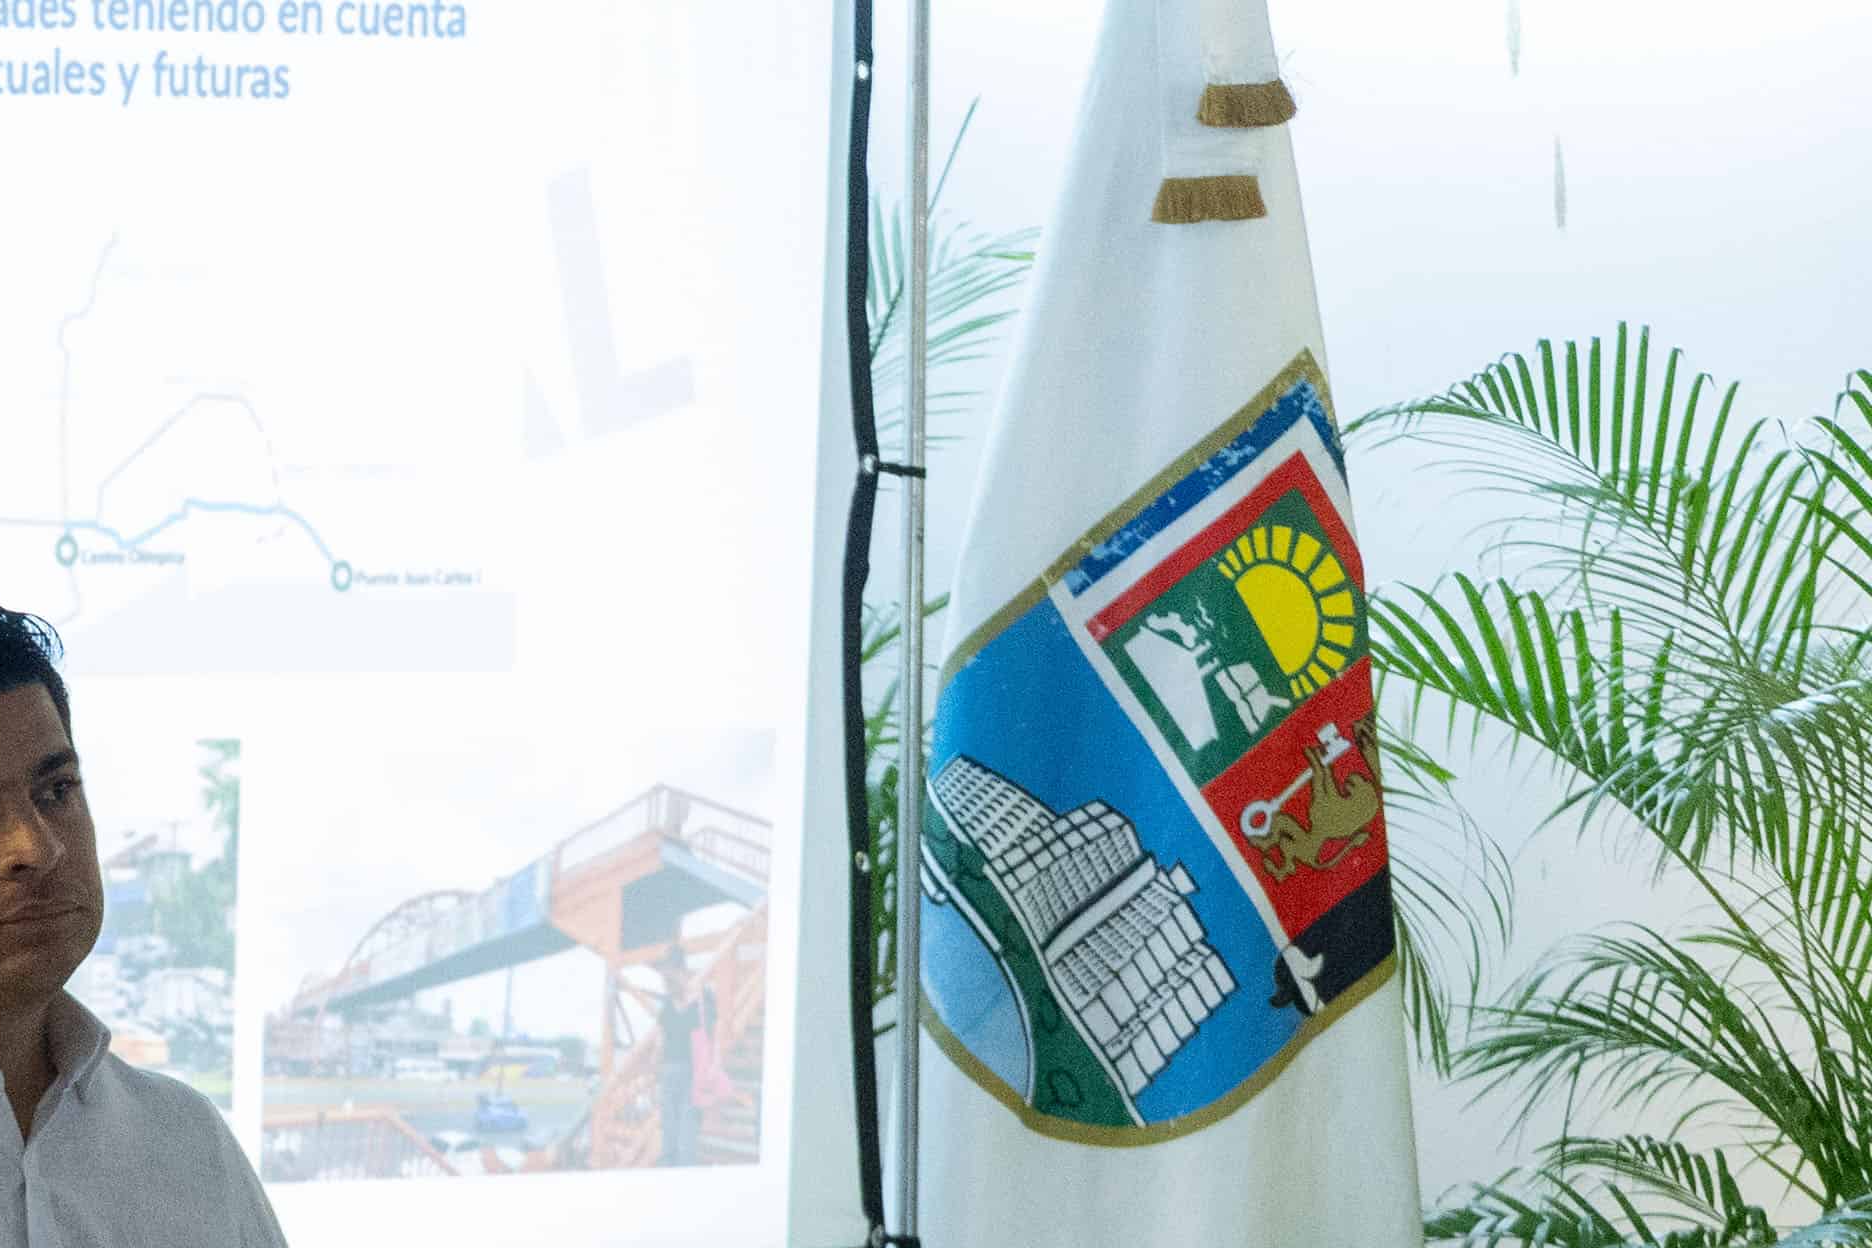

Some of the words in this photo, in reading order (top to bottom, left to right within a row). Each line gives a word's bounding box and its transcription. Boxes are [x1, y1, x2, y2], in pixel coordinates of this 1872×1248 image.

[93, 0, 267, 34] teniendo
[275, 0, 324, 36] en
[335, 0, 469, 40] cuenta
[116, 61, 142, 108] y
[151, 48, 291, 101] futuras
